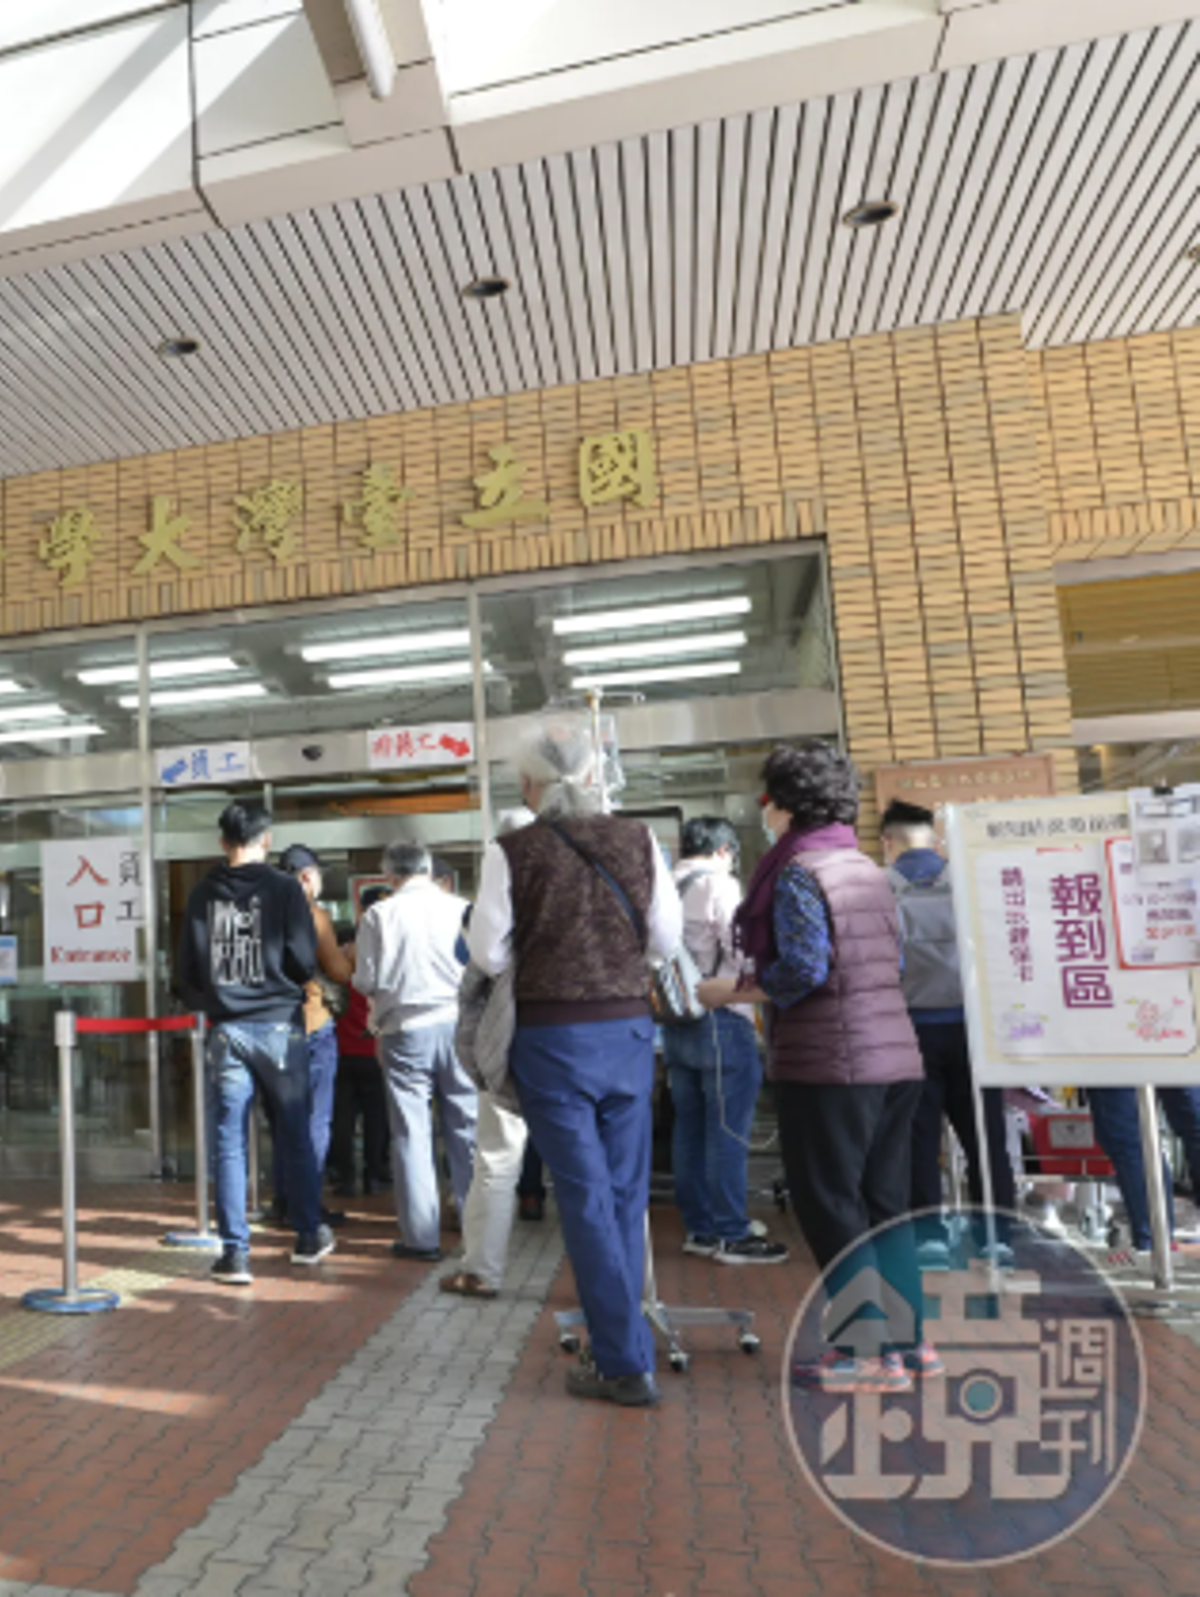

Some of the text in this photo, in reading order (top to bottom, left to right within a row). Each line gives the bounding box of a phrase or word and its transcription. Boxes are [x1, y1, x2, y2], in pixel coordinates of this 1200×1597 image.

[66, 855, 109, 929] 入口
[1050, 873, 1114, 1008] 報到區
